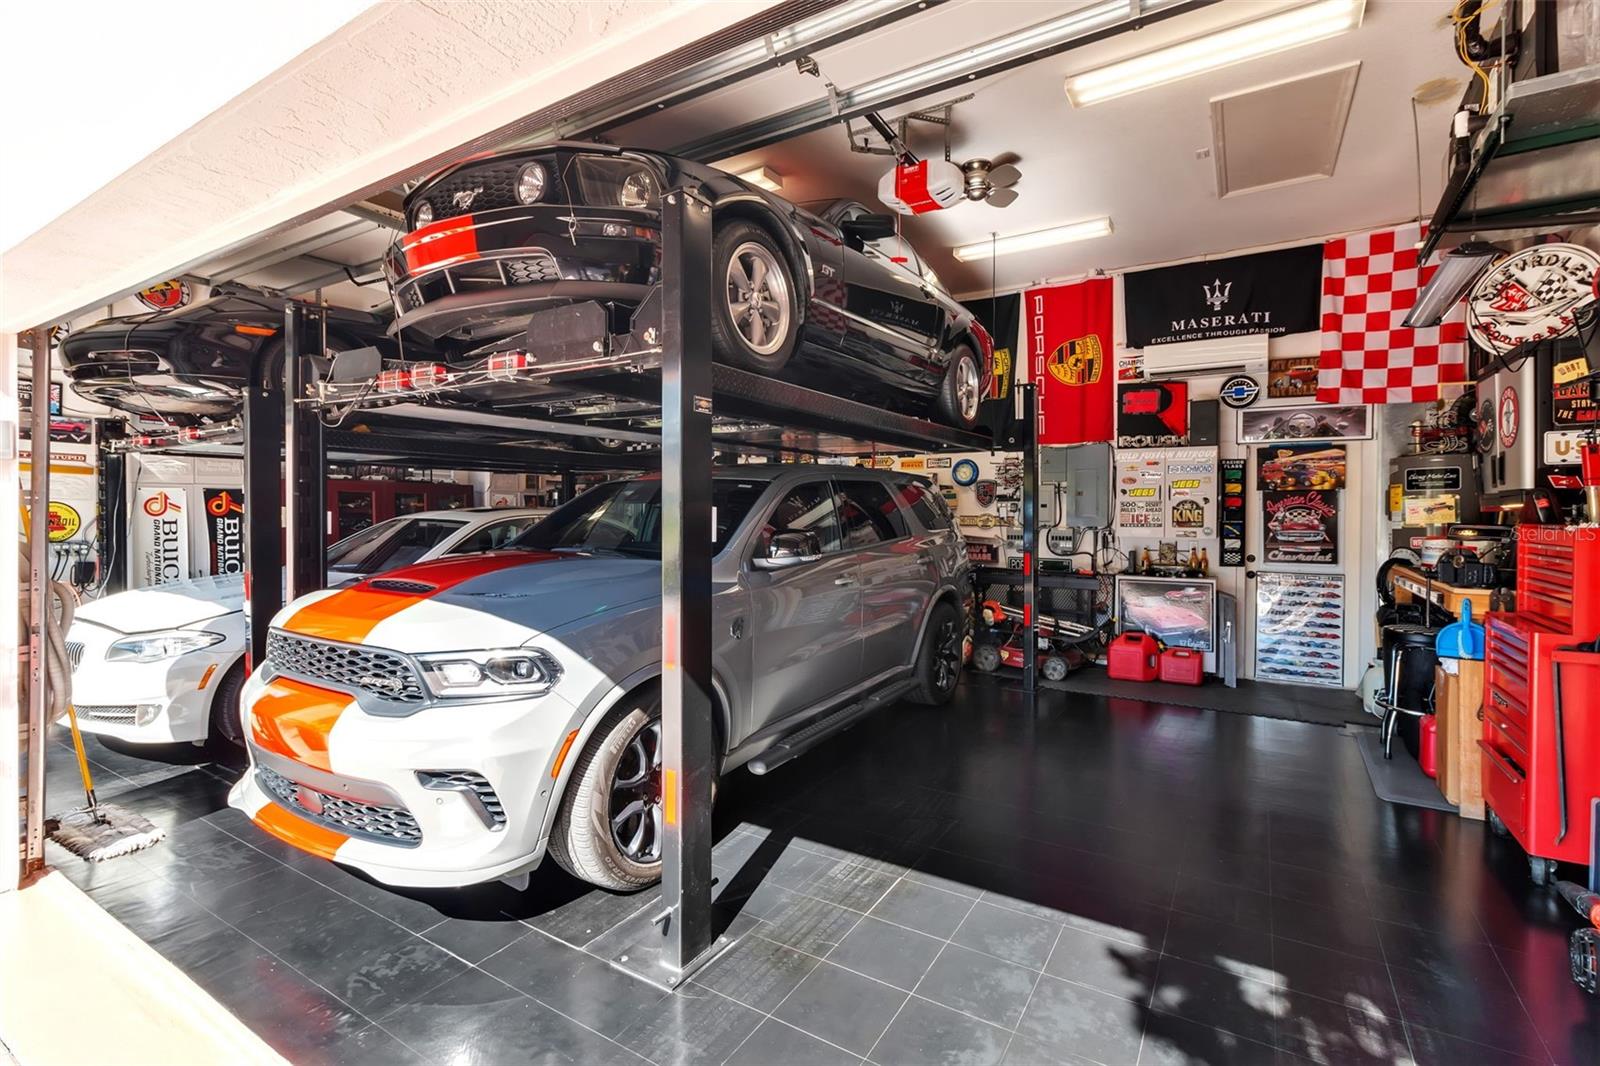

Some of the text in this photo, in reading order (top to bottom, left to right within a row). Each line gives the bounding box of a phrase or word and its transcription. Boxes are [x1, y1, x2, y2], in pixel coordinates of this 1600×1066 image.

[821, 264, 836, 278] GT
[1171, 312, 1272, 332] MASERATI
[1151, 326, 1286, 345] EXCELLENCE THROUGH PASSION
[1034, 295, 1045, 435] PORSCHE
[1288, 358, 1320, 369] GARAG
[1288, 383, 1317, 396] RULE
[1557, 409, 1574, 419] THE
[1118, 433, 1189, 447] ROUSH
[1180, 465, 1213, 473] RICHMOND
[1173, 480, 1200, 488] JEGS
[1130, 488, 1156, 497] JEGS
[1131, 513, 1151, 523] ICE
[1173, 509, 1202, 522] KING
[153, 519, 161, 547] GRAND
[162, 518, 180, 585] BUIC
[224, 517, 241, 575] BUIC
[1268, 550, 1332, 562] Chevrolet
